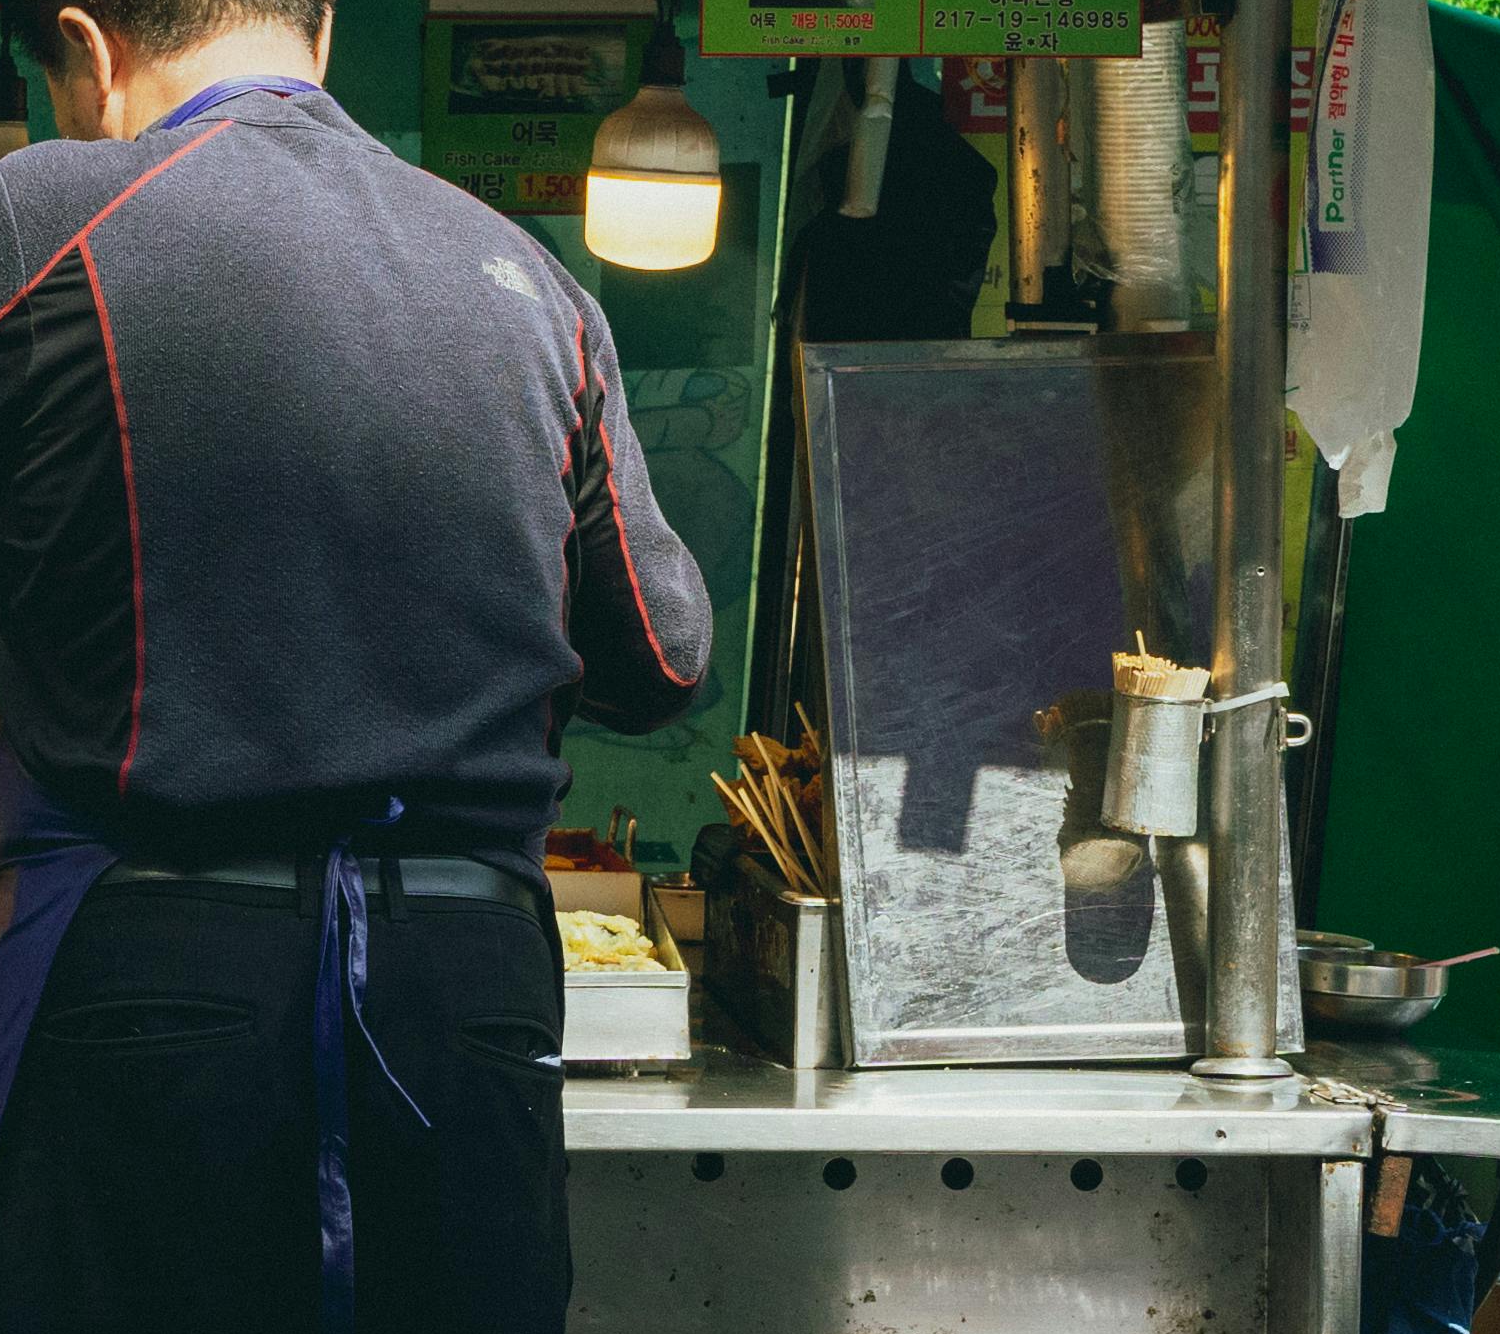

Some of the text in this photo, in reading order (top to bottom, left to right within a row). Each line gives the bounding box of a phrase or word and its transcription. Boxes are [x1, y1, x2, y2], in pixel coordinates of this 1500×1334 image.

[750, 12, 777, 29] 어묵
[822, 12, 875, 30] 1,500원
[934, 10, 1129, 29] 217-19-146985
[512, 121, 558, 147] 어묵
[445, 152, 521, 166] Fish Cake
